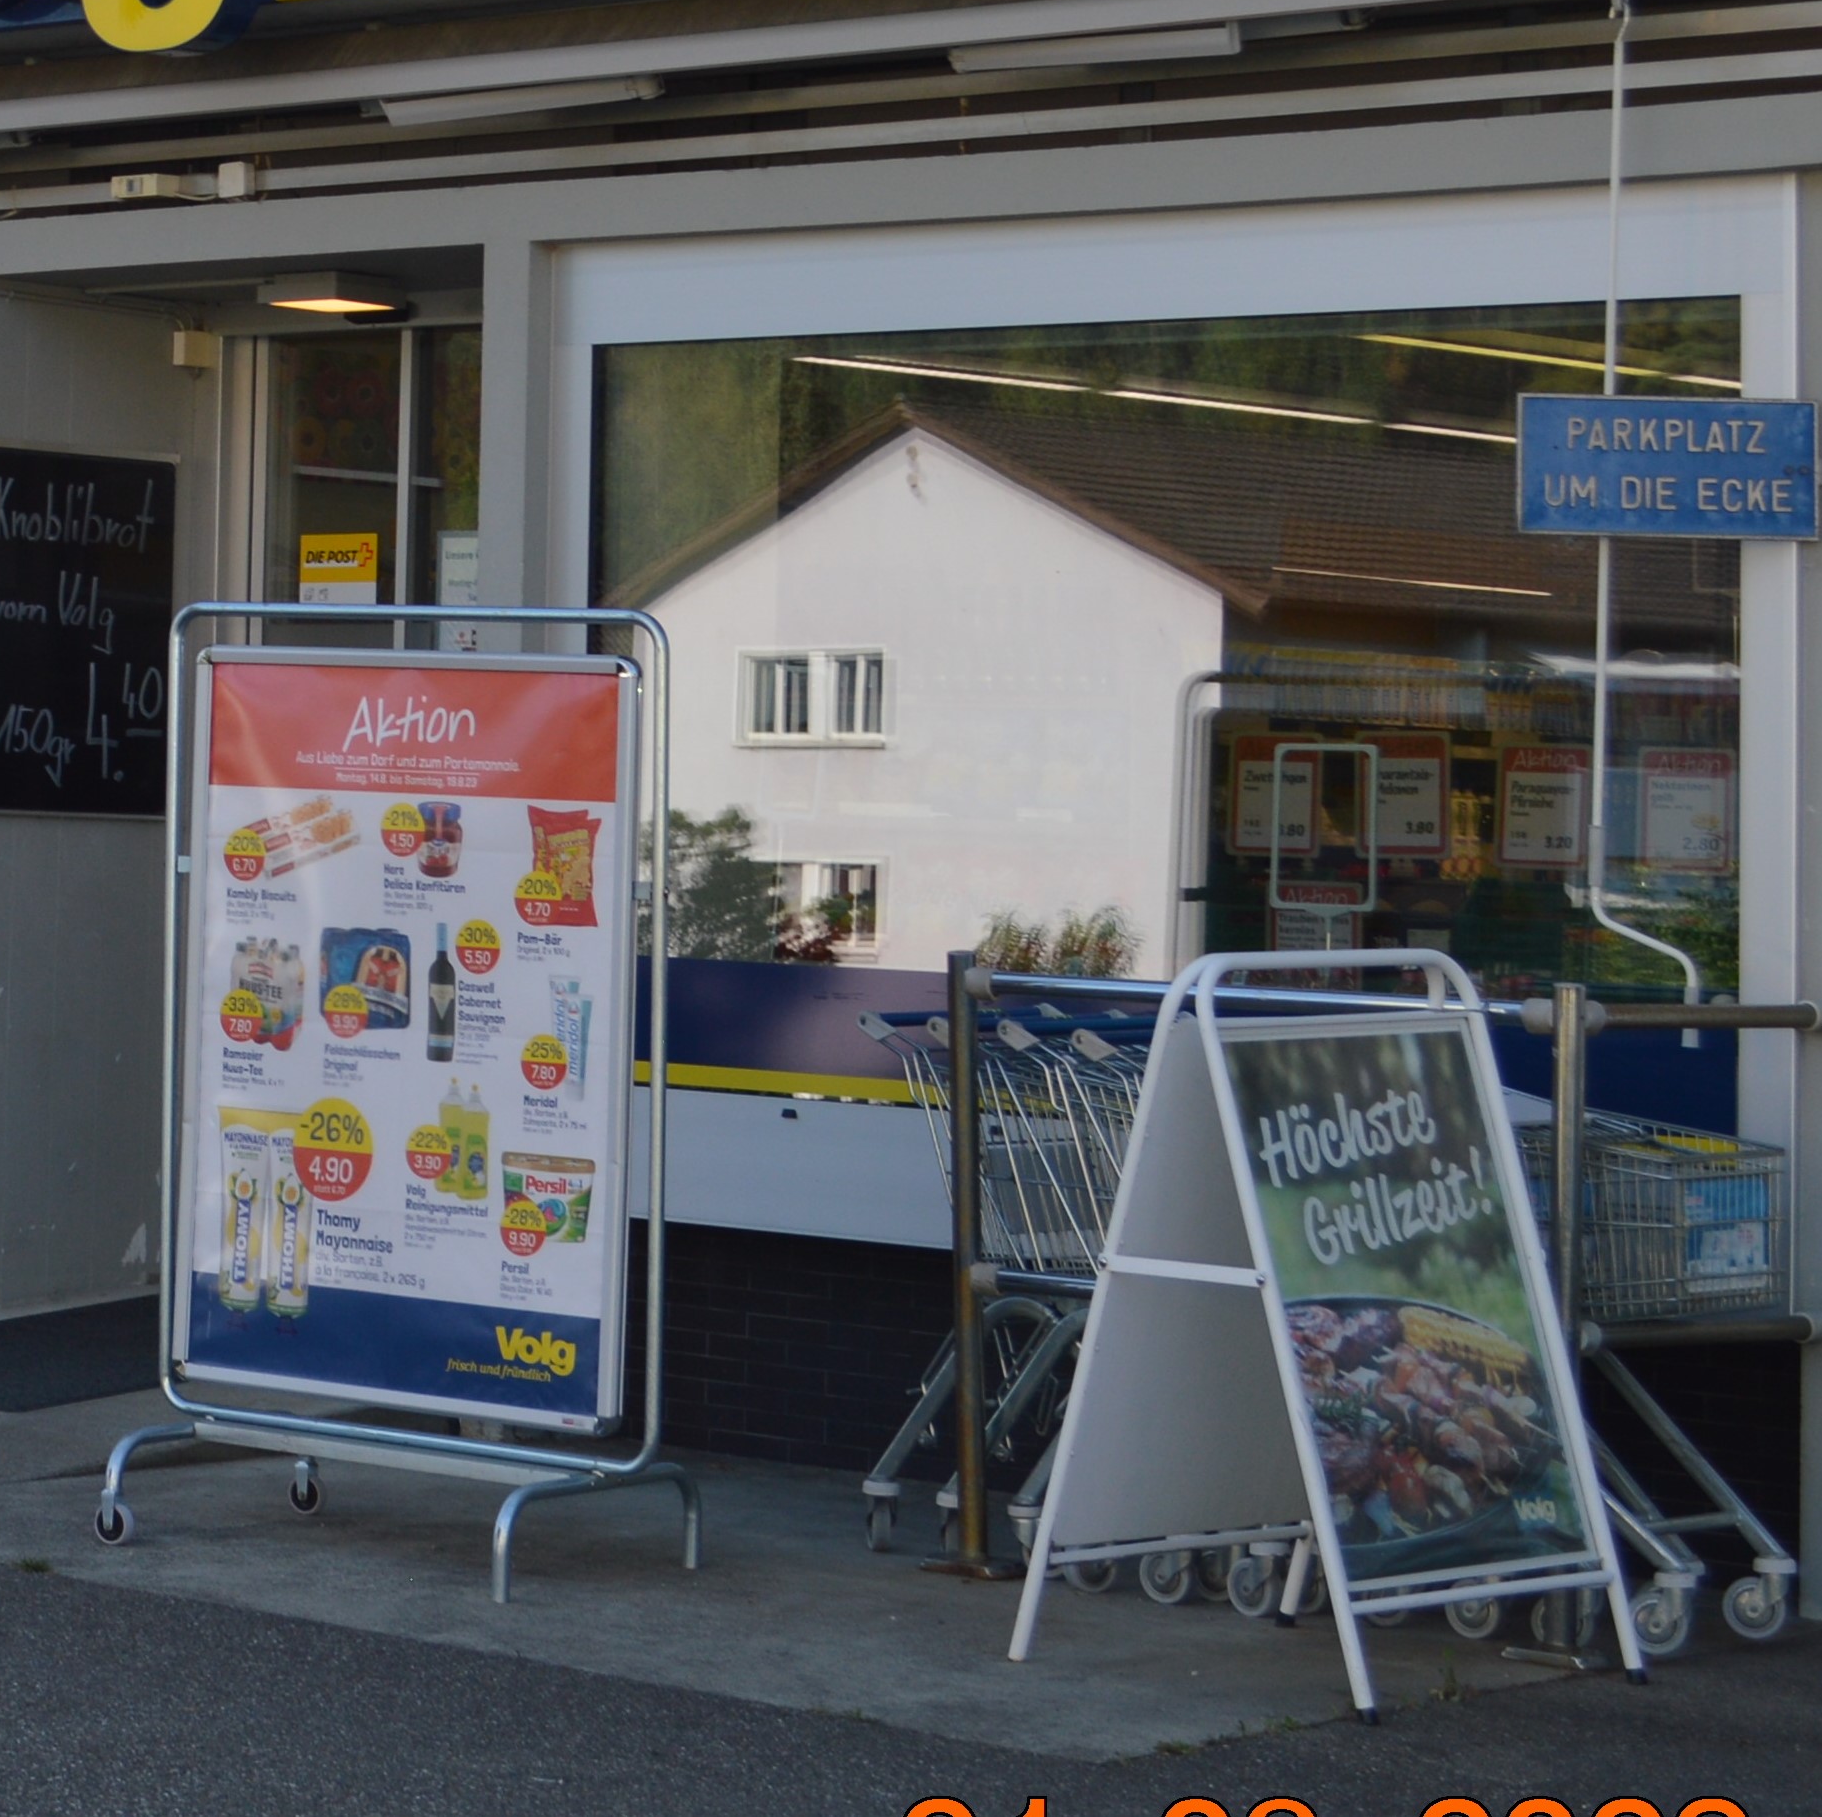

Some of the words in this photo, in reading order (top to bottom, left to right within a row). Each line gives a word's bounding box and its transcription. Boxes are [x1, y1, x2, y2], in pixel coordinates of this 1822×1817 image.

[1566, 417, 1767, 455] PARKPLATZ
[1543, 474, 1597, 508] UM
[1620, 476, 1677, 511] DIE
[1697, 478, 1794, 513] ECKE
[306, 550, 326, 564] DIE
[327, 550, 359, 563] POST
[60, 570, 115, 655] Volg
[342, 696, 475, 752] Aktion
[296, 751, 315, 763] Aus
[316, 751, 344, 765] Liebe
[346, 755, 369, 766] zum
[371, 754, 395, 767] Dorf
[396, 755, 417, 768] und
[418, 758, 441, 769] zum
[1511, 750, 1578, 770] Aktion
[1657, 756, 1722, 775] Aktion
[385, 810, 419, 827] -21%
[1405, 821, 1435, 835] 3.80
[228, 835, 262, 852] -20%
[389, 833, 415, 848] 4.50
[1544, 835, 1573, 850] 3.20
[1683, 837, 1720, 851] 2.80
[232, 858, 256, 872] 6.70
[227, 887, 258, 901] Kambly
[518, 879, 557, 896] -20%
[1286, 887, 1348, 904] Aktion
[524, 902, 551, 917] 4.70
[458, 927, 496, 945] -30%
[517, 931, 562, 946] Pom-Bär
[464, 950, 491, 966] 5.50
[458, 980, 495, 994] Caswell
[223, 997, 258, 1014] -33%
[328, 992, 363, 1010] -28%
[458, 994, 502, 1009] Cabernet
[229, 1018, 253, 1033] 7.80
[458, 1010, 506, 1026] Sauvignon
[555, 998, 566, 1046] eridol
[223, 1047, 264, 1061] Ramseier
[525, 1042, 563, 1060] -25%
[568, 1018, 579, 1076] meridol
[222, 1062, 263, 1076] Huus-Tee
[323, 1058, 358, 1073] Original
[531, 1064, 557, 1081] 7.80
[523, 1095, 558, 1109] Meridol
[300, 1111, 365, 1146] -26%
[411, 1132, 447, 1149] -22%
[1258, 1087, 1437, 1188] Höchste
[309, 1155, 354, 1185] 4.90
[414, 1154, 442, 1170] 3.90
[406, 1184, 426, 1199] Volg
[525, 1174, 567, 1195] Persil
[405, 1198, 489, 1217] Reinigungsmittel
[1304, 1147, 1494, 1266] Grillzeit!
[317, 1209, 361, 1232] Thomy
[505, 1208, 542, 1227] -28%
[233, 1199, 251, 1283] THOMY
[281, 1204, 298, 1289] THOMY
[316, 1231, 393, 1255] Mayonnaise
[509, 1230, 536, 1247] 9.90
[501, 1260, 530, 1275] Persil
[382, 1271, 389, 1283] 2
[495, 1325, 576, 1376] Volg
[445, 1358, 477, 1373] frisch
[479, 1362, 500, 1376] und
[500, 1364, 551, 1382] fründlich
[1513, 1495, 1557, 1524] Volg
